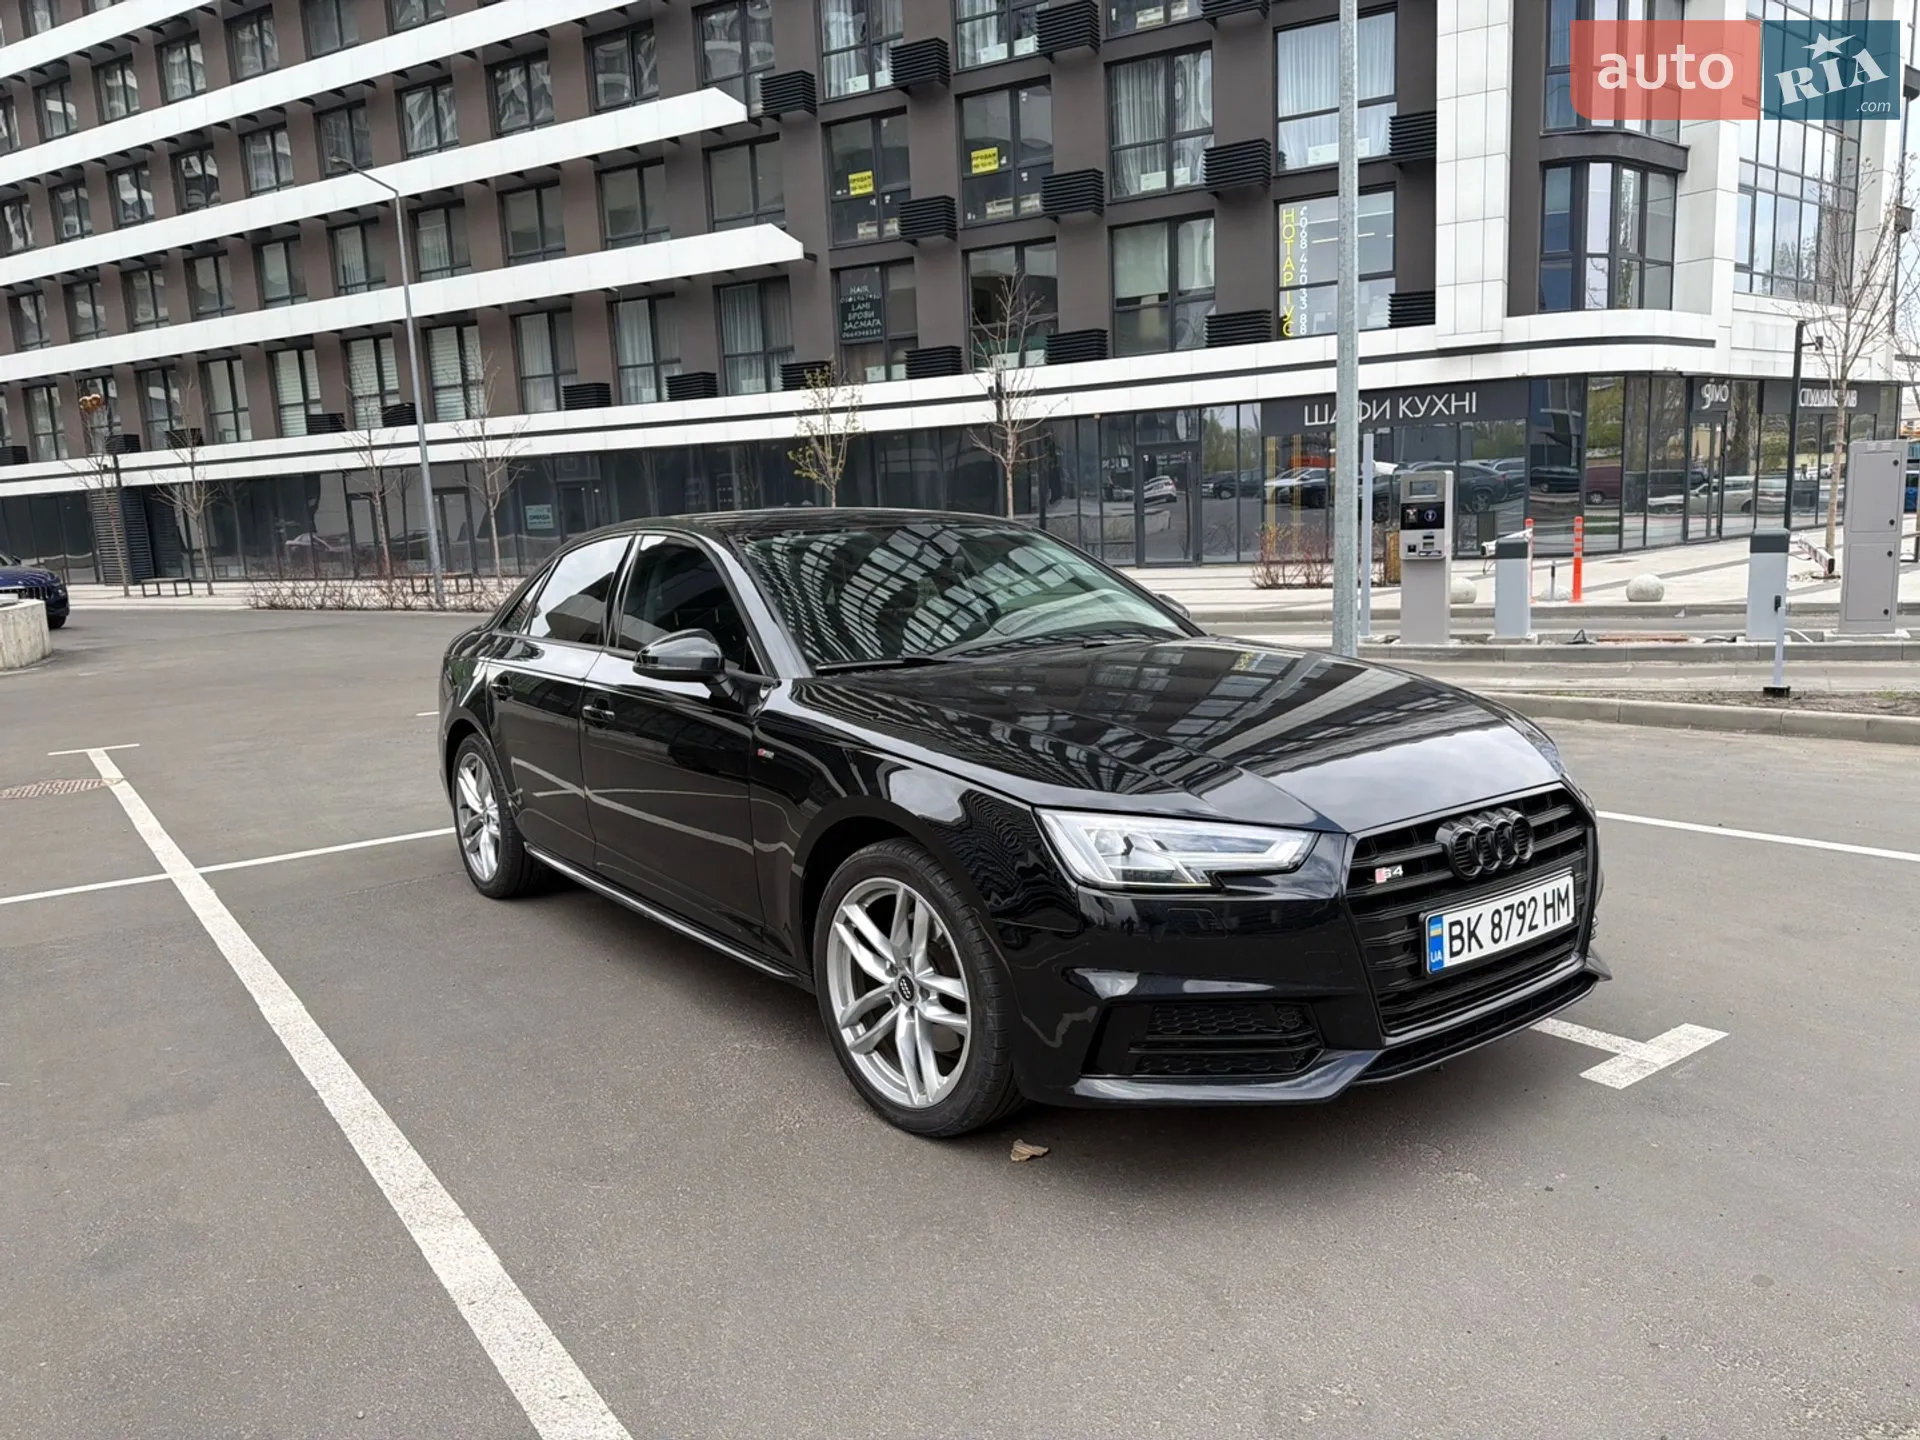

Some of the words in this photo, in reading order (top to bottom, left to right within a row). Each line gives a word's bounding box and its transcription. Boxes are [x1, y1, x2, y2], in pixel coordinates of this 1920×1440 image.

[1282, 207, 1295, 337] НОТАРІУС
[1399, 391, 1477, 419] КУХНІ
[1448, 912, 1484, 958] BK
[1490, 895, 1539, 945] 8792
[1543, 882, 1571, 927] HM
[1430, 949, 1443, 963] UA
